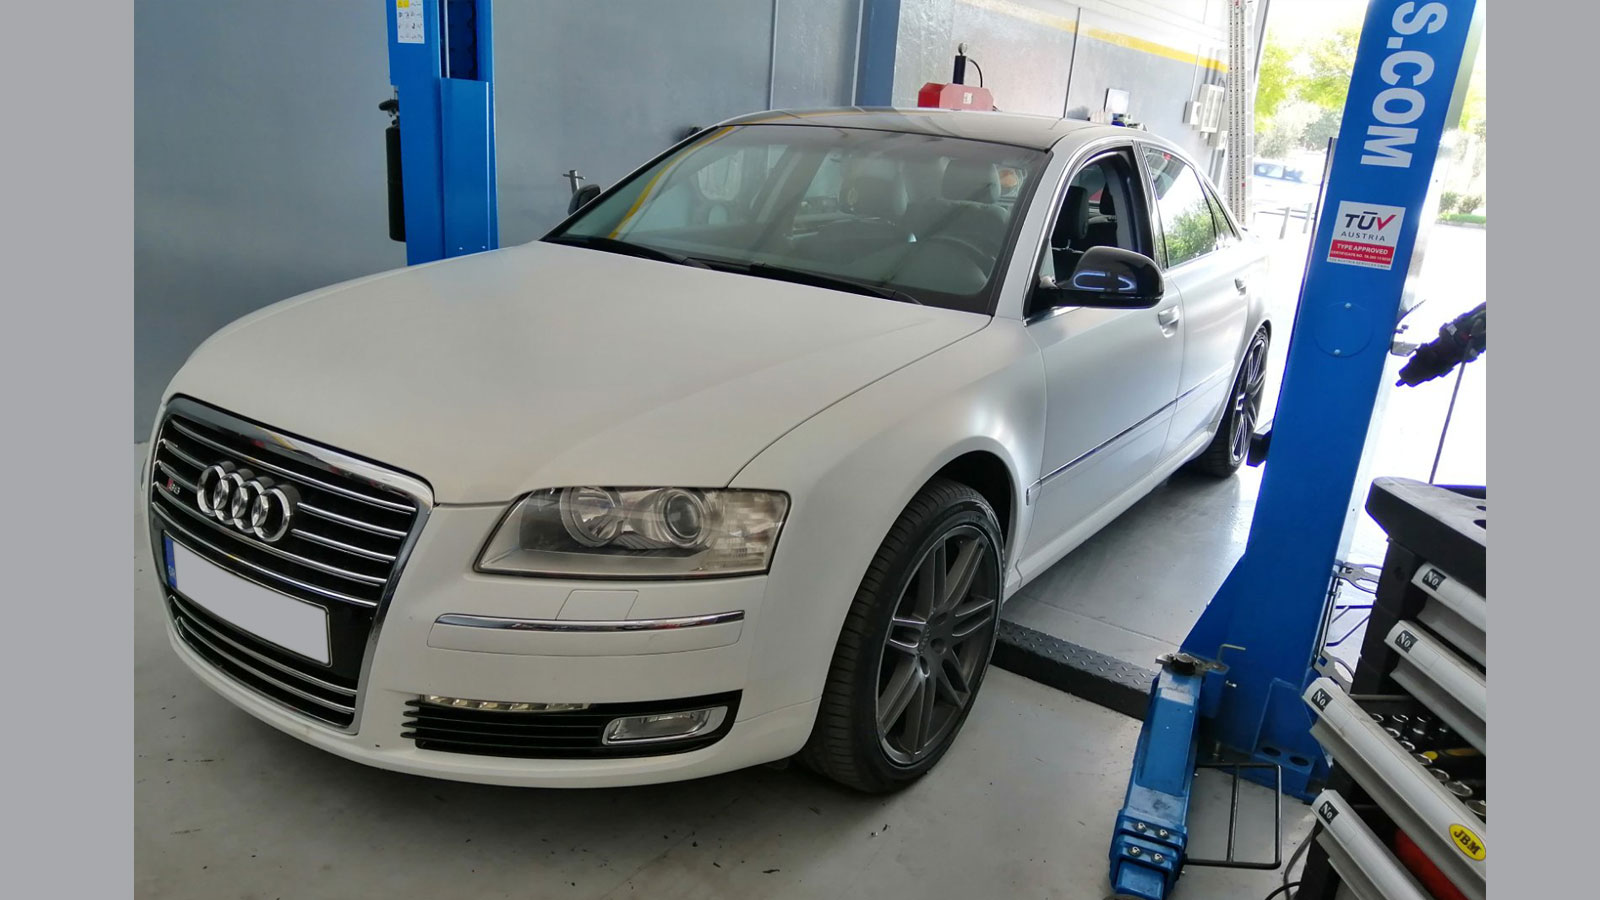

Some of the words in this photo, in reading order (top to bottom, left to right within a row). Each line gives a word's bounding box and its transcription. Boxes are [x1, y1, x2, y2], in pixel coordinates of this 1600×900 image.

[1341, 231, 1385, 241] AUSTRIA
[1353, 245, 1388, 255] APPROVED
[1454, 830, 1481, 855] JBM
